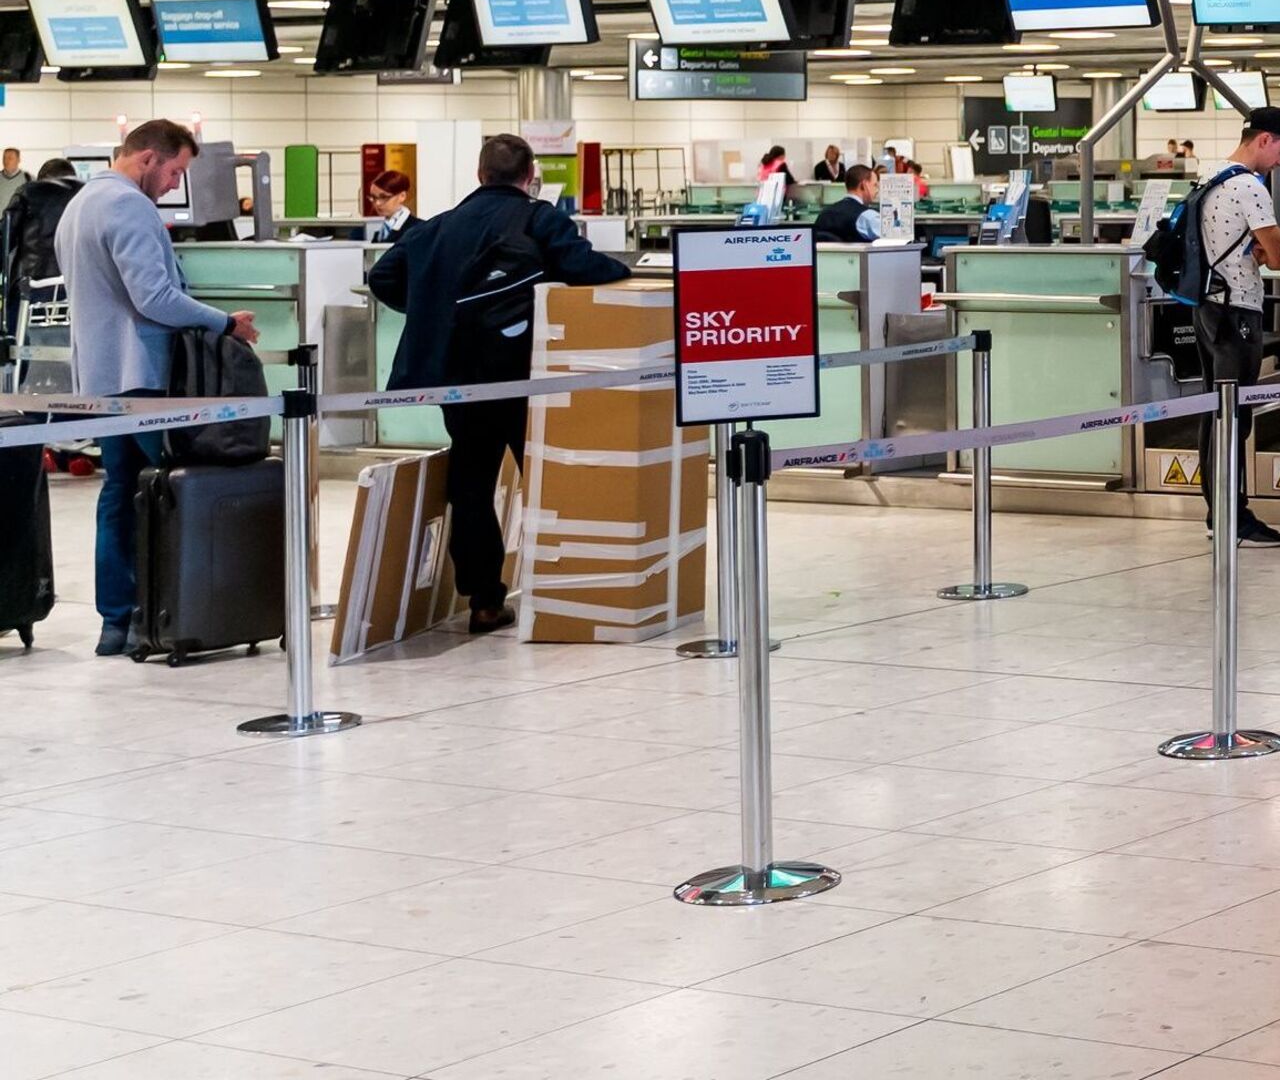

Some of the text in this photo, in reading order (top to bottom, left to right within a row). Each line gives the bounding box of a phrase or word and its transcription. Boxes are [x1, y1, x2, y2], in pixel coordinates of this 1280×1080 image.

[1033, 142, 1074, 156] Departure
[724, 235, 791, 245] AIRFRANCE
[765, 253, 792, 262] KLM
[685, 310, 736, 329] SKY
[639, 372, 675, 381] AIRFRAN
[364, 395, 417, 406] AIRFRANCE
[137, 414, 191, 428] AIRFRANCE
[1080, 415, 1123, 430] AIRFRANCE
[783, 453, 838, 468] AIRFRANCE
